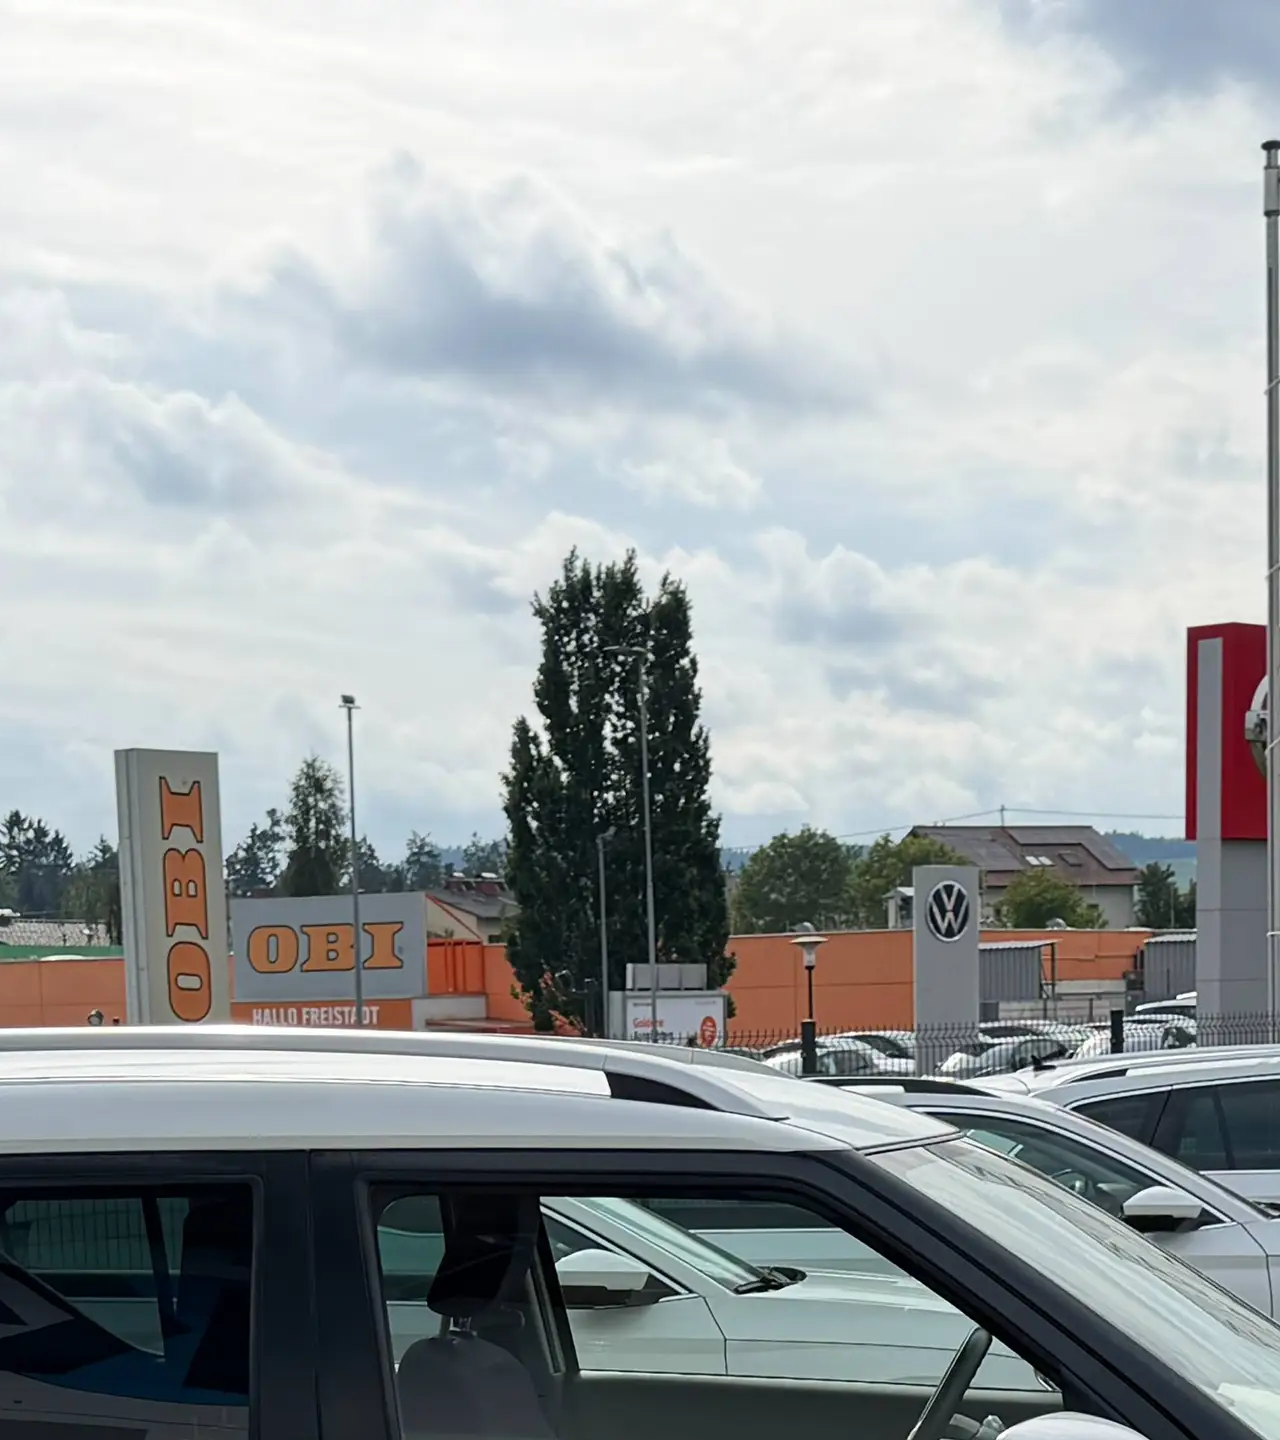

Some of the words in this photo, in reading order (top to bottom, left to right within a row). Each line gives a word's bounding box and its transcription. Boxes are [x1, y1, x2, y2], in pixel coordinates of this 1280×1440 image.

[159, 776, 212, 1022] OBI
[247, 921, 404, 974] OBI
[252, 1008, 297, 1026] HALLO
